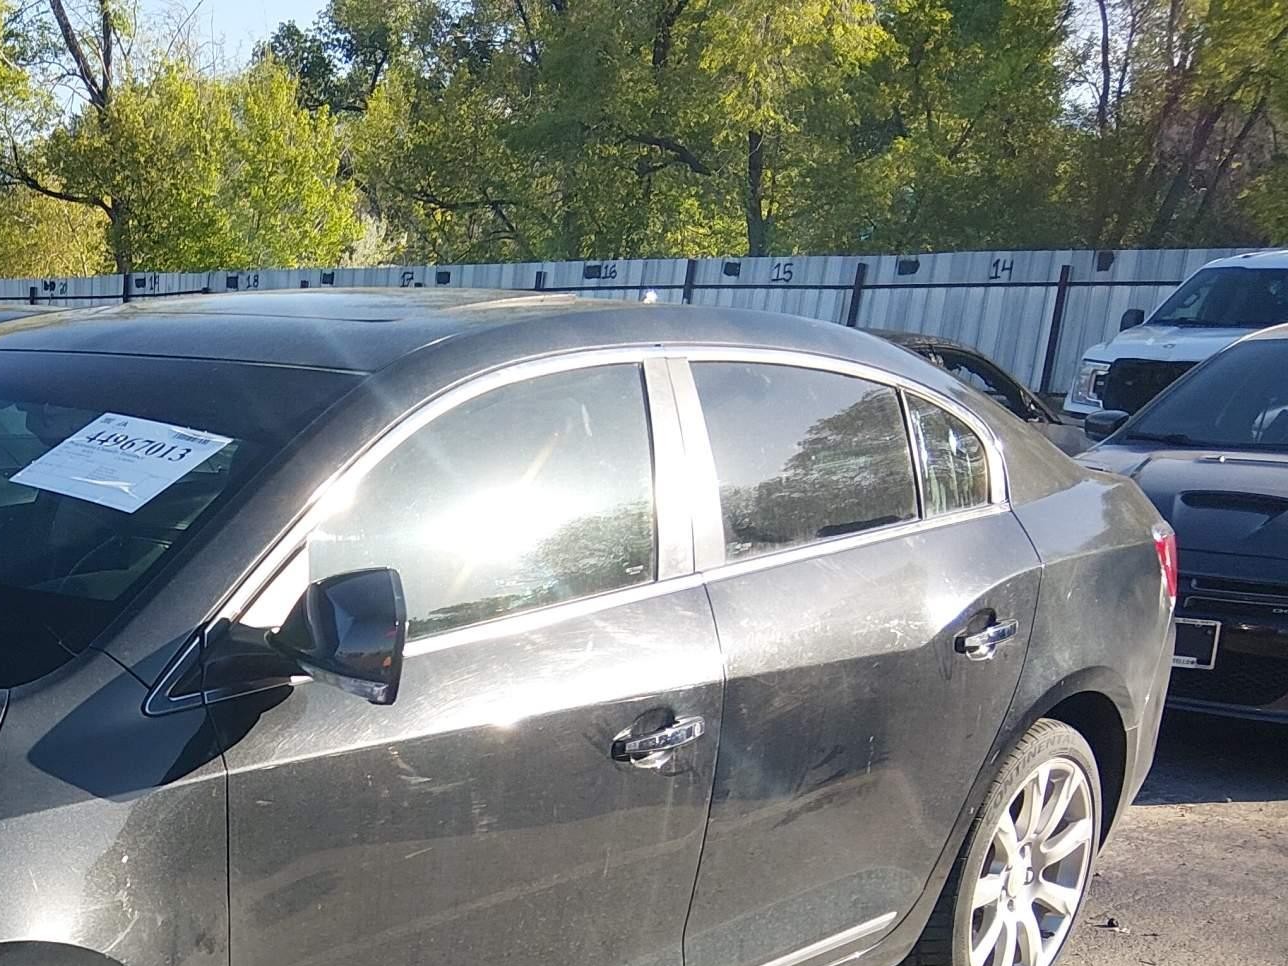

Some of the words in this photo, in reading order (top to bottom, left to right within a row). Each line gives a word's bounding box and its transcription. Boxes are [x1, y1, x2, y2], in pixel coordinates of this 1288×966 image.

[601, 264, 618, 280] 16
[771, 262, 794, 283] 15
[989, 258, 1014, 281] 14
[246, 273, 260, 289] 18
[85, 430, 193, 462] 44967013
